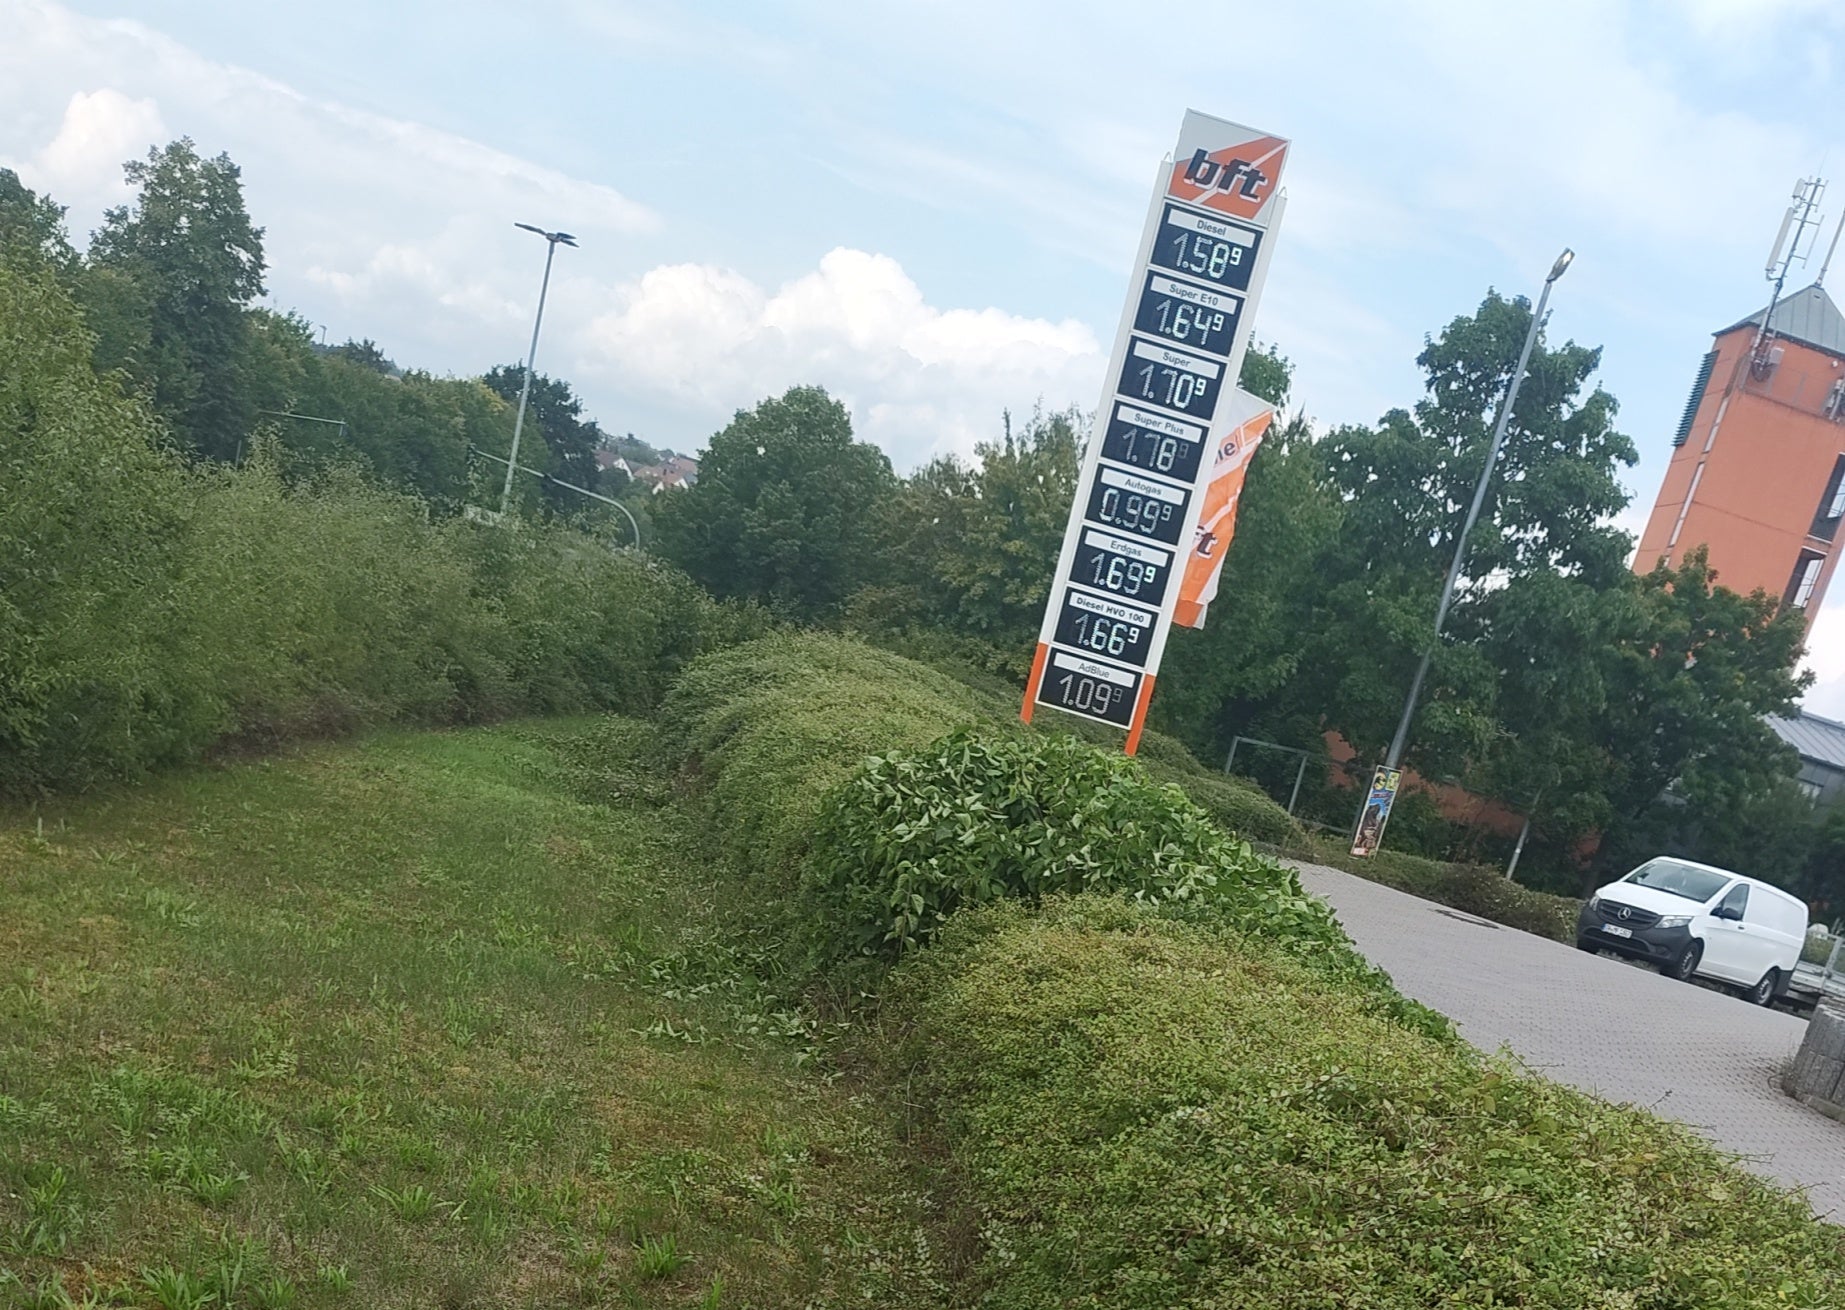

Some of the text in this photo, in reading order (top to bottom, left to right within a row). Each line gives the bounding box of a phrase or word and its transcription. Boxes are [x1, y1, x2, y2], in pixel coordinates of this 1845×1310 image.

[1184, 148, 1267, 201] bft
[1196, 220, 1227, 237] Diesel
[1168, 284, 1219, 306] Super E10
[1162, 351, 1191, 368] Super
[1134, 413, 1185, 435] Super Plus
[1124, 477, 1162, 497] Autogas
[1110, 540, 1142, 557] Erdgas
[1076, 597, 1145, 624] Diesel HVO 100
[1078, 662, 1111, 679] AdBlue
